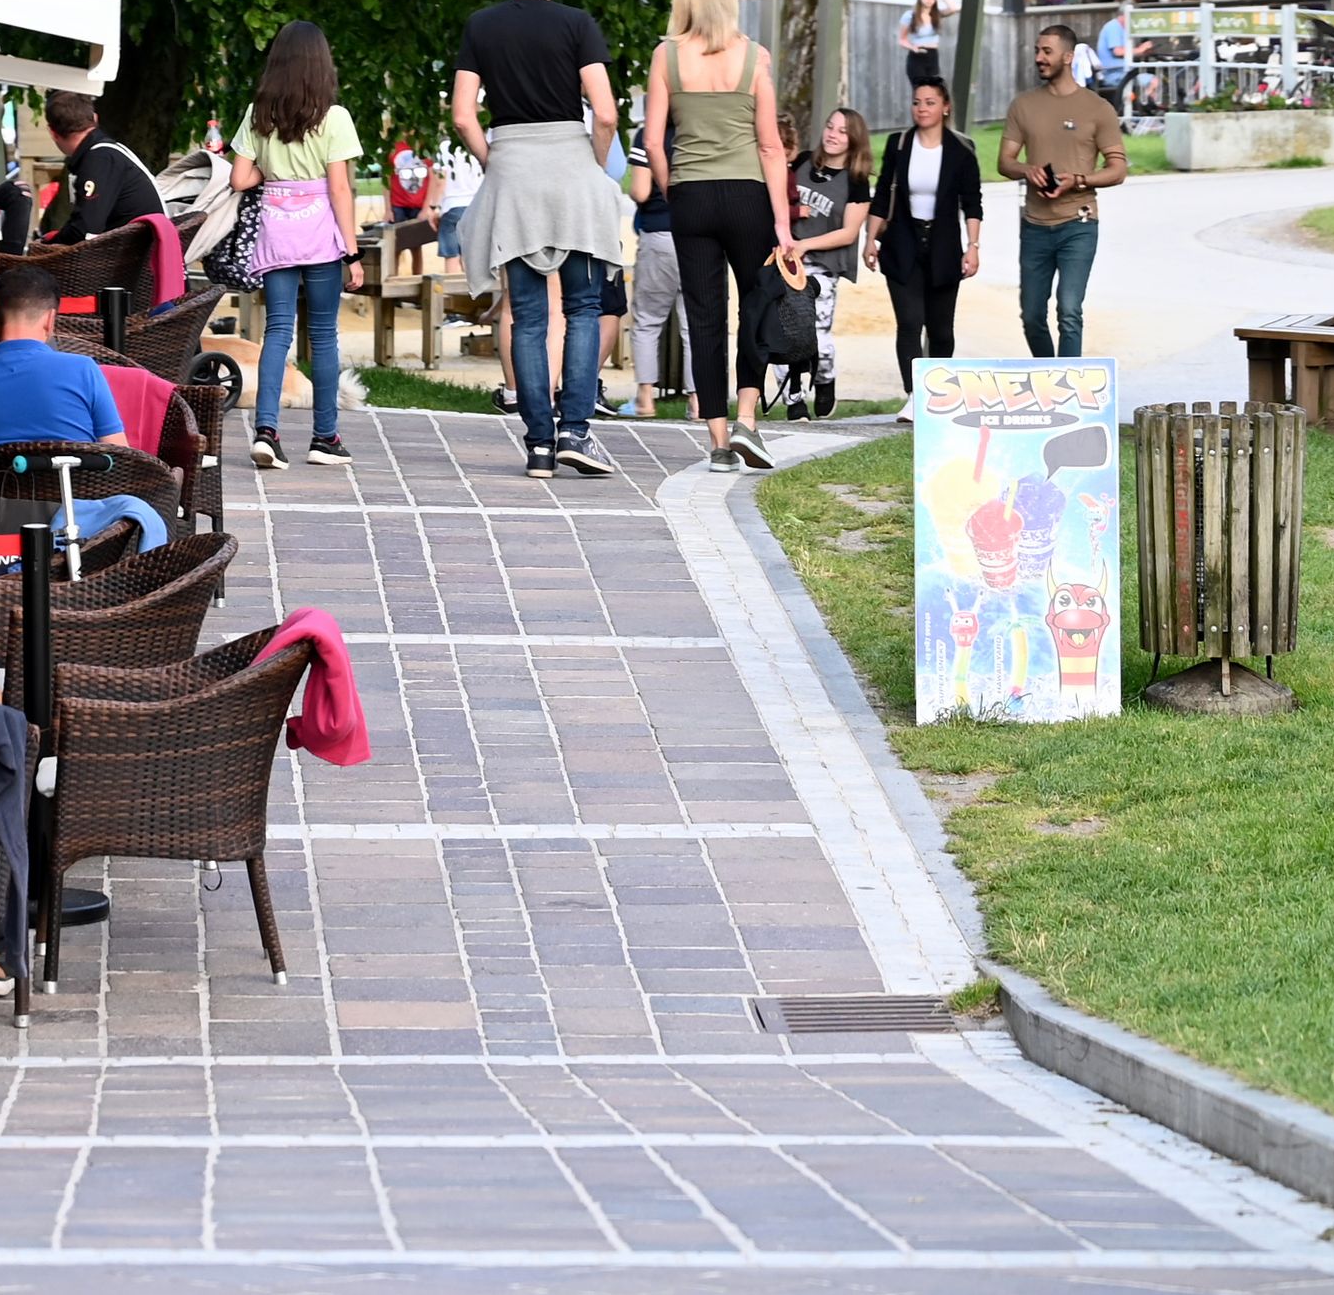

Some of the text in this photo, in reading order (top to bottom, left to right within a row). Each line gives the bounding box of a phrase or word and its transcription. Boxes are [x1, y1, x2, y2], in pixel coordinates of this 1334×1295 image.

[924, 367, 1107, 414] SNEKY
[980, 415, 1052, 426] ICE DRINKS
